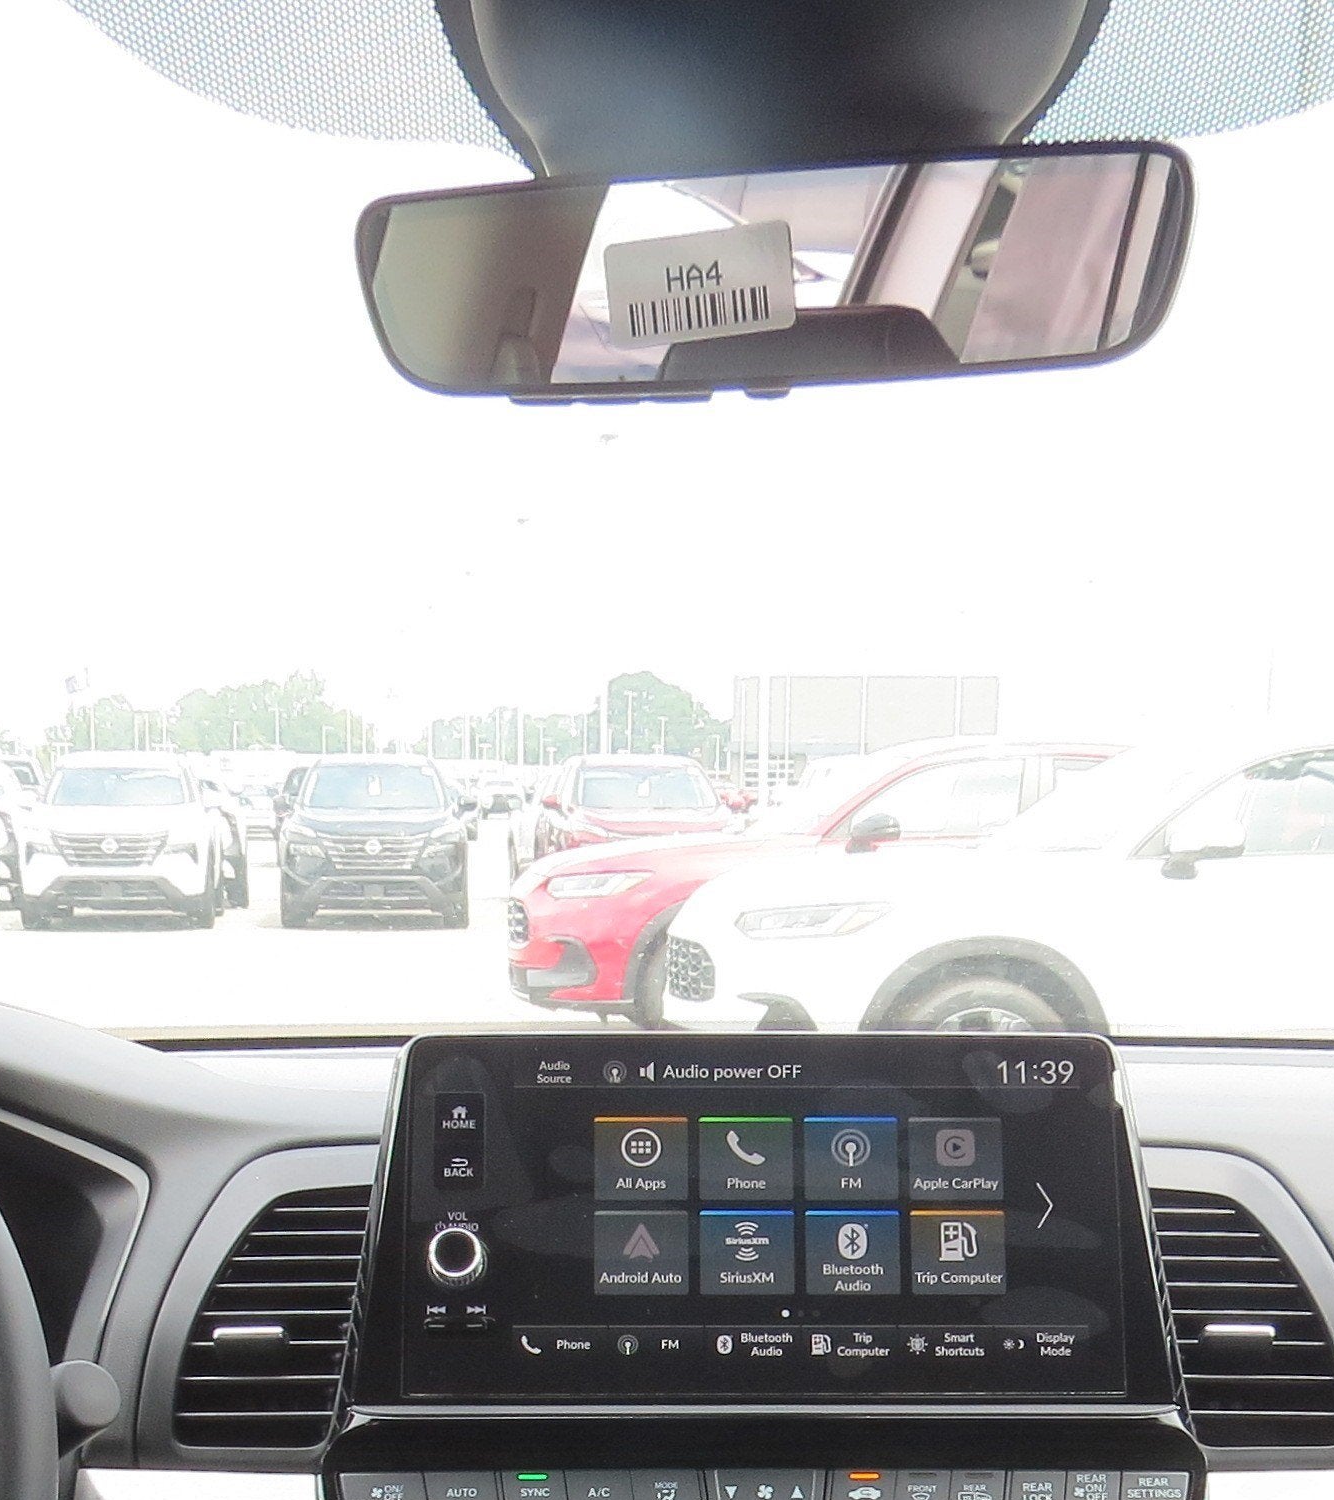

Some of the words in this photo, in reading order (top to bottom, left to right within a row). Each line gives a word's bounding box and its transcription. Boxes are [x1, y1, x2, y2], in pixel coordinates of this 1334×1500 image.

[666, 260, 723, 293] HA4
[539, 1060, 571, 1071] Audio
[662, 1064, 709, 1079] Audio
[713, 1067, 763, 1082] power
[767, 1064, 802, 1079] OFF
[997, 1060, 1074, 1085] 11:39
[536, 1074, 572, 1084] Source
[442, 1120, 476, 1130] HOME
[444, 1167, 474, 1178] BACK
[616, 1178, 634, 1189] All
[635, 1178, 666, 1192] Apps
[727, 1178, 766, 1189] Phone
[841, 1178, 862, 1189] FM
[913, 1178, 949, 1192] Apple
[952, 1178, 999, 1192] CarPlay
[447, 1211, 469, 1221] VOL
[822, 1263, 884, 1276] Bluetooth
[600, 1271, 649, 1284] Android
[651, 1272, 682, 1284] Auto
[720, 1271, 774, 1284] SiriusXM
[915, 1272, 938, 1287] Trip
[941, 1272, 1003, 1287] Computer
[834, 1280, 871, 1292] Audio
[740, 1333, 793, 1344] Bluetooth
[853, 1333, 873, 1346] Trip
[944, 1333, 975, 1343] Smart
[1036, 1333, 1075, 1346] Display
[556, 1339, 591, 1350] Phone
[661, 1339, 680, 1350] FM
[750, 1346, 783, 1357] Audio
[837, 1346, 890, 1359] Computer
[935, 1346, 985, 1357] Shortcuts
[1040, 1346, 1072, 1357] Mode
[1076, 1474, 1107, 1483] REAR
[1138, 1477, 1169, 1487] REAR
[384, 1484, 404, 1493] ON/
[654, 1481, 679, 1490] MODE
[907, 1484, 938, 1493] FRONT
[963, 1484, 987, 1492] REAR
[1022, 1482, 1053, 1492] REAR
[1085, 1484, 1107, 1493] ON/
[383, 1493, 404, 1500] OFF
[446, 1488, 478, 1498] AUTO
[520, 1487, 551, 1497] SYNC
[587, 1486, 611, 1499] A/C
[1127, 1488, 1182, 1499] SETTINGS
